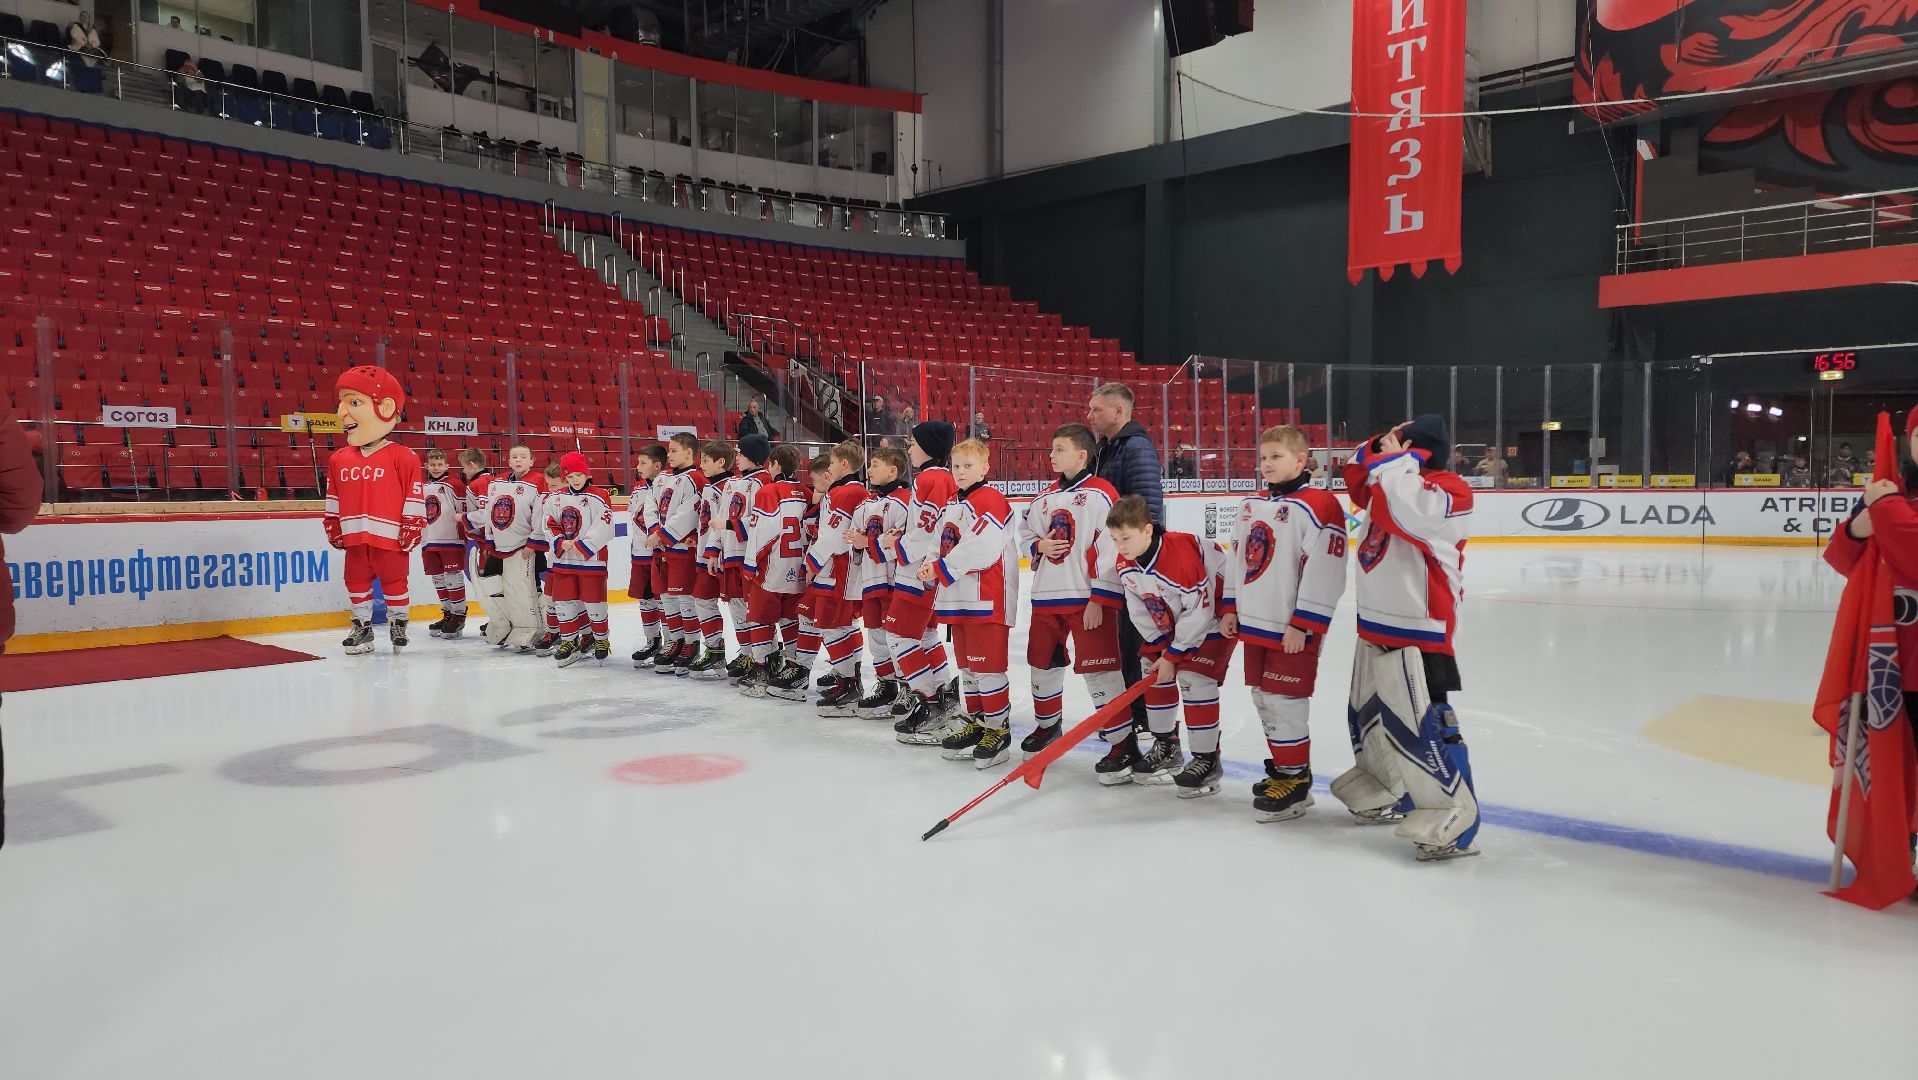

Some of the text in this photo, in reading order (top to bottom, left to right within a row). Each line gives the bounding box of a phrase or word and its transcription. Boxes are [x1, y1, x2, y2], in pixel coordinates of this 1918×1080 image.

[110, 410, 169, 423] согаз
[427, 420, 475, 432] KHL.RU
[550, 425, 595, 435] OLIMBET
[412, 481, 422, 495] 5
[828, 513, 842, 529] 16
[1620, 504, 1716, 525] LADA
[1783, 517, 1802, 533] &
[1327, 533, 1346, 558] 18
[1081, 656, 1117, 667] BAUER
[1262, 670, 1302, 684] BAUER
